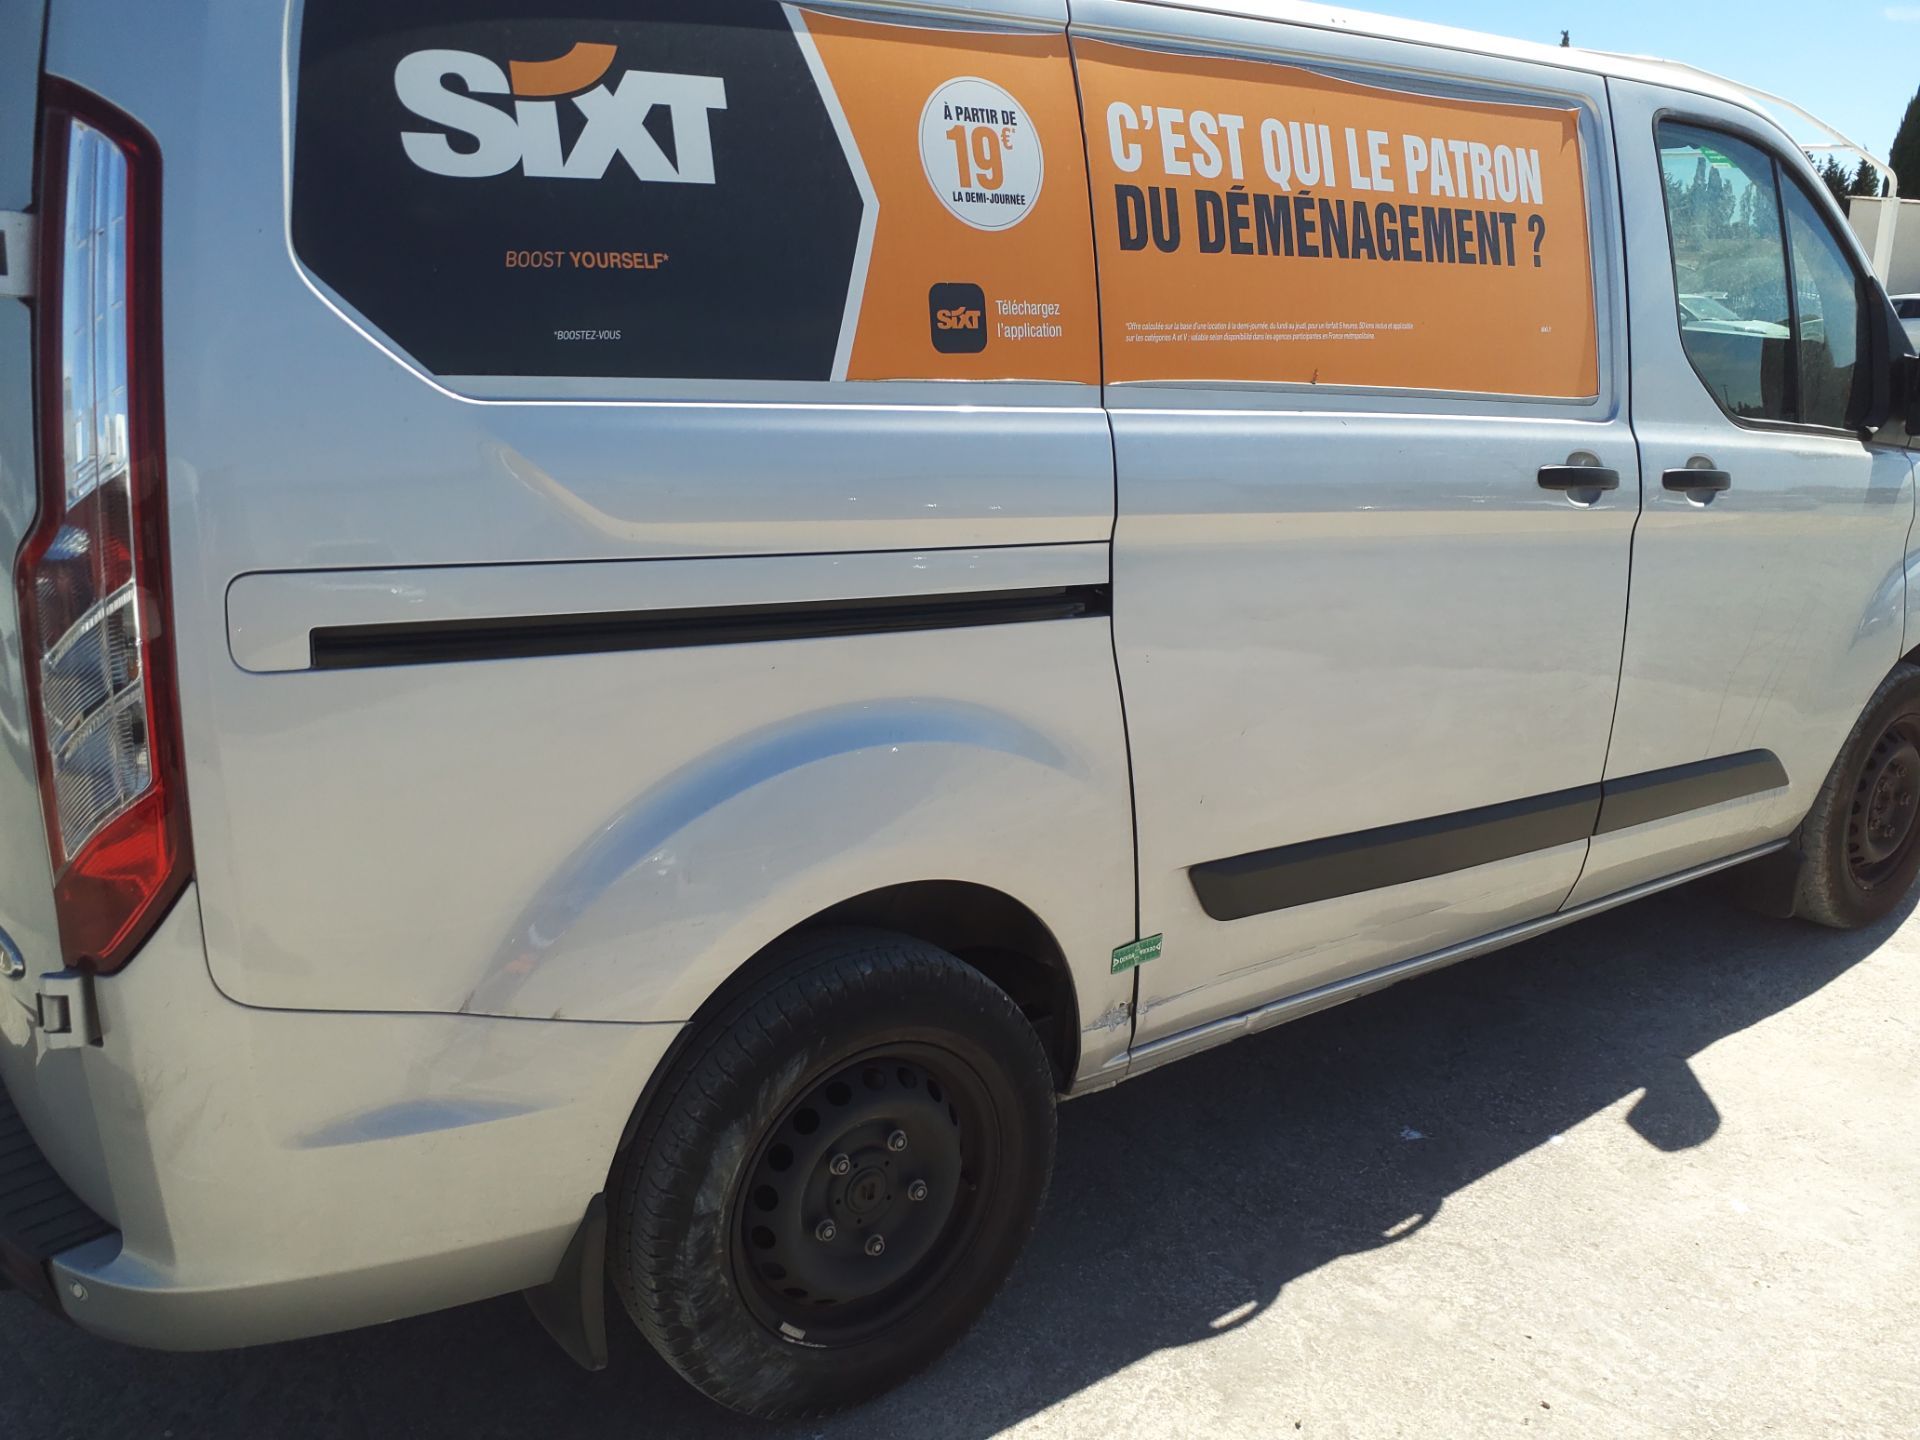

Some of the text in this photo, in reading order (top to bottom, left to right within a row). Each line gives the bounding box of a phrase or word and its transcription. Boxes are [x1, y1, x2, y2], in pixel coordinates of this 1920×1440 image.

[944, 101, 1018, 126] À PARTIR DE
[1106, 101, 1543, 205] C'EST QUI LE PATRON
[953, 191, 1026, 205] LA DEMI-JOURNÉE
[1114, 184, 1546, 268] DU DÉMÉNAGEMENT ?
[505, 251, 566, 269] BOOST
[995, 299, 1061, 317] Téléchargez
